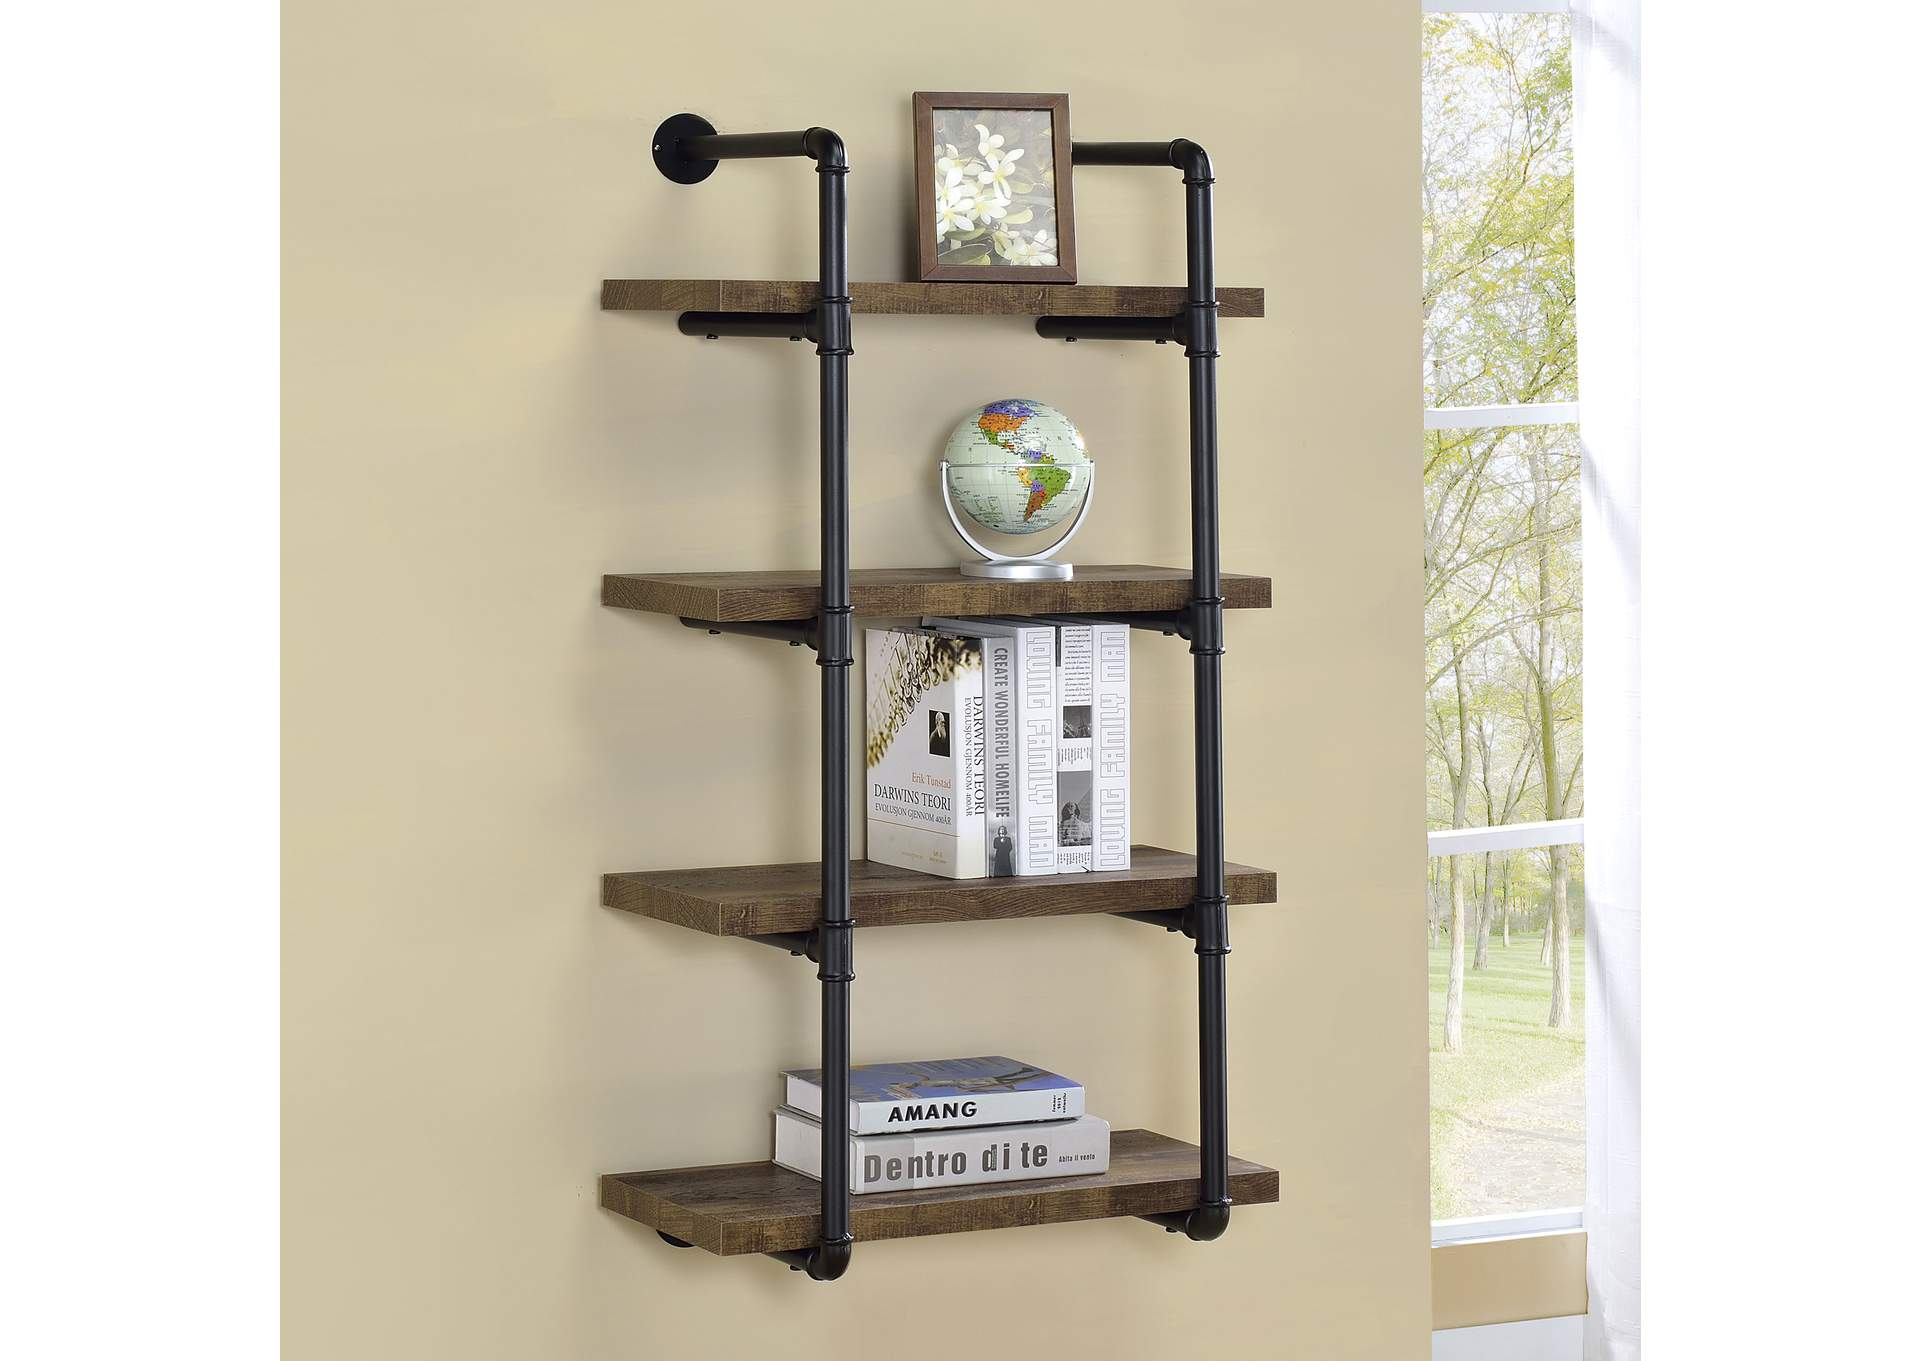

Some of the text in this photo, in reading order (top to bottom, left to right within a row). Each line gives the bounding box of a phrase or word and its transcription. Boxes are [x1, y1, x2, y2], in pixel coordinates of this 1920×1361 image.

[1100, 631, 1125, 682] MAN
[963, 697, 973, 746] EVOLUSJON
[994, 647, 1010, 818] CREATE WONDERFUL HOMELIFE
[1100, 693, 1125, 778] FAMILY
[912, 771, 952, 789] Erik Tunstad
[963, 748, 973, 790] GJENNOM
[973, 696, 985, 816] DARWINS TEORI
[1027, 719, 1053, 804] FAMILY
[874, 783, 952, 811] DARWINS TEORI
[875, 802, 907, 816] EVOLUSJON
[908, 808, 935, 822] GJENNOM
[1028, 815, 1054, 868] MAN
[888, 1101, 978, 1123] AMANG
[864, 1141, 1048, 1183] Dentro di te
